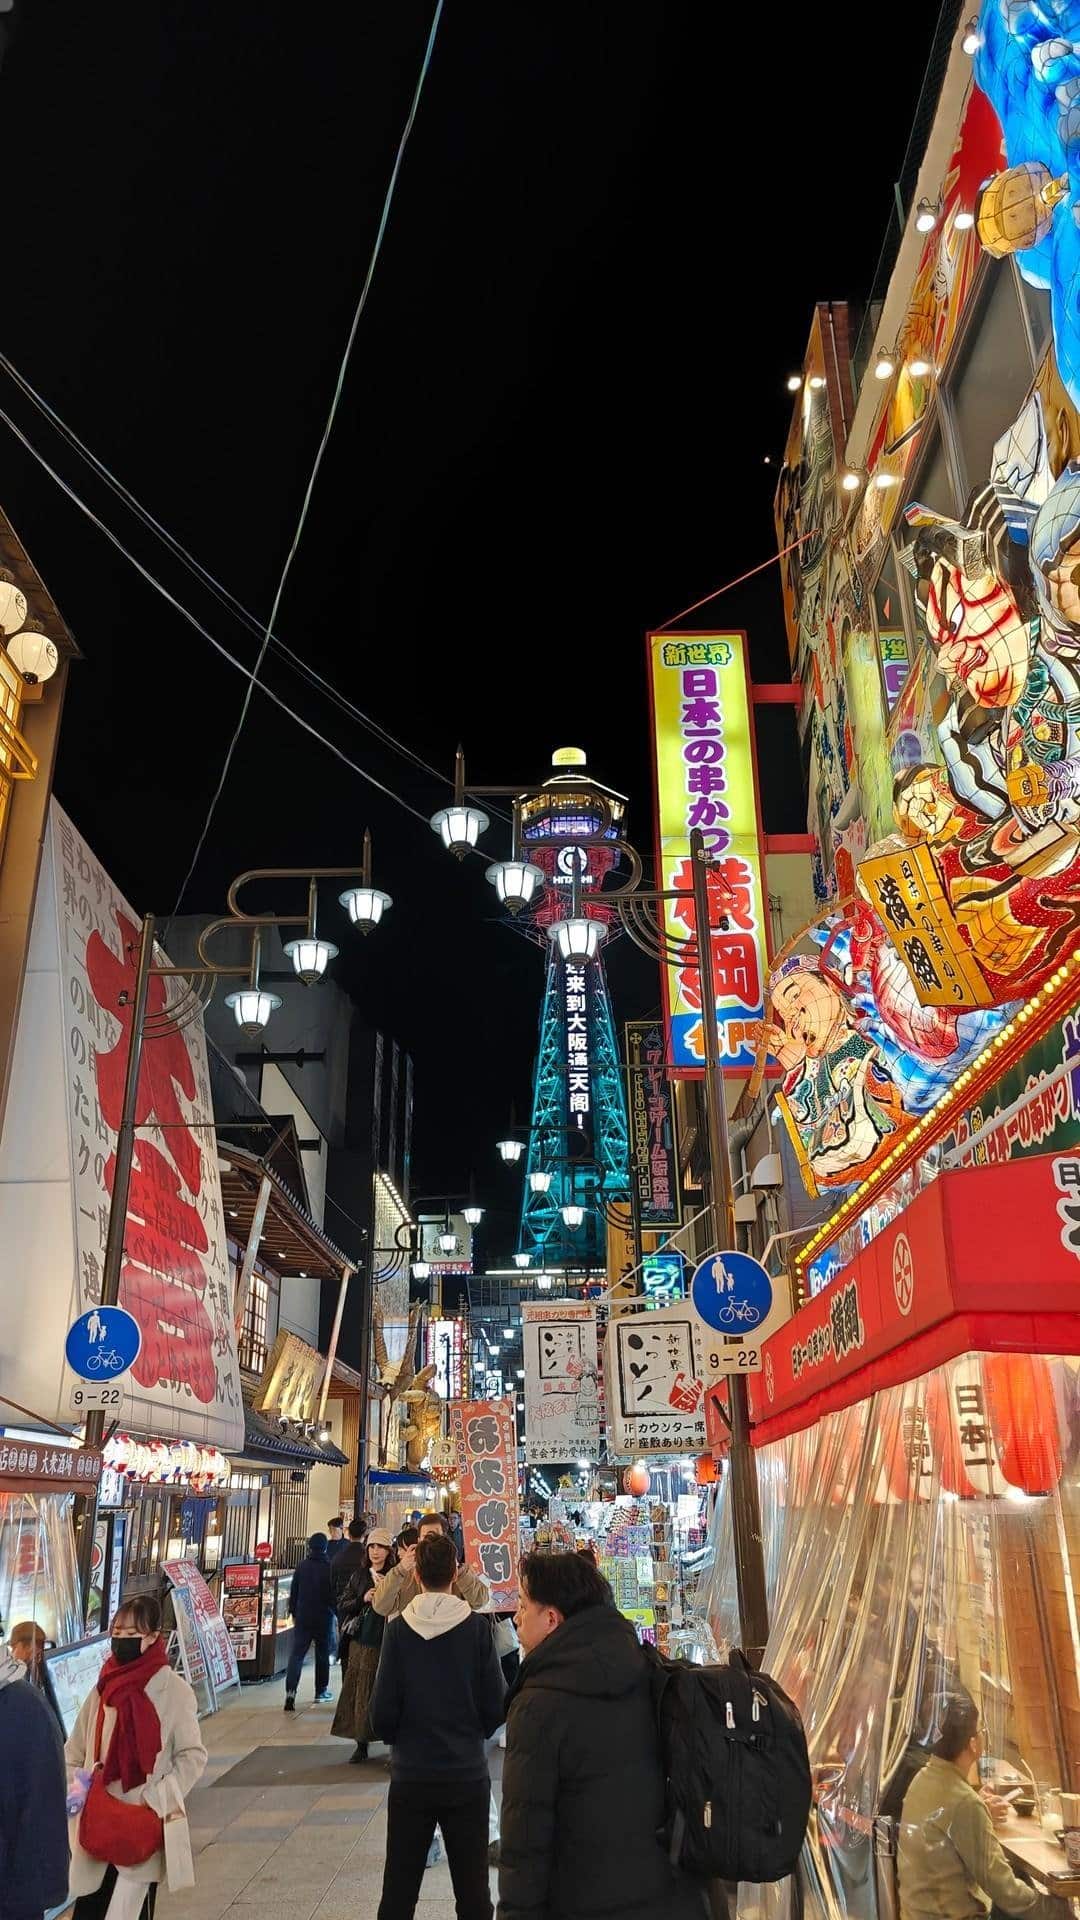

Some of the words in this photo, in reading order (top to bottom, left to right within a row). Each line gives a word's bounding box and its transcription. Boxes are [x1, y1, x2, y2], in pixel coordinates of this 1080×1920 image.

[664, 644, 731, 664] 新世界
[683, 669, 729, 854] 日本一の串かつ
[553, 875, 593, 884] HITAHI
[624, 1424, 634, 1433] 1F
[638, 1422, 705, 1433] カウンター席
[956, 1384, 995, 1466] 日本一
[624, 1438, 635, 1448] 2F
[529, 1447, 597, 1459] 宴会予約受付中
